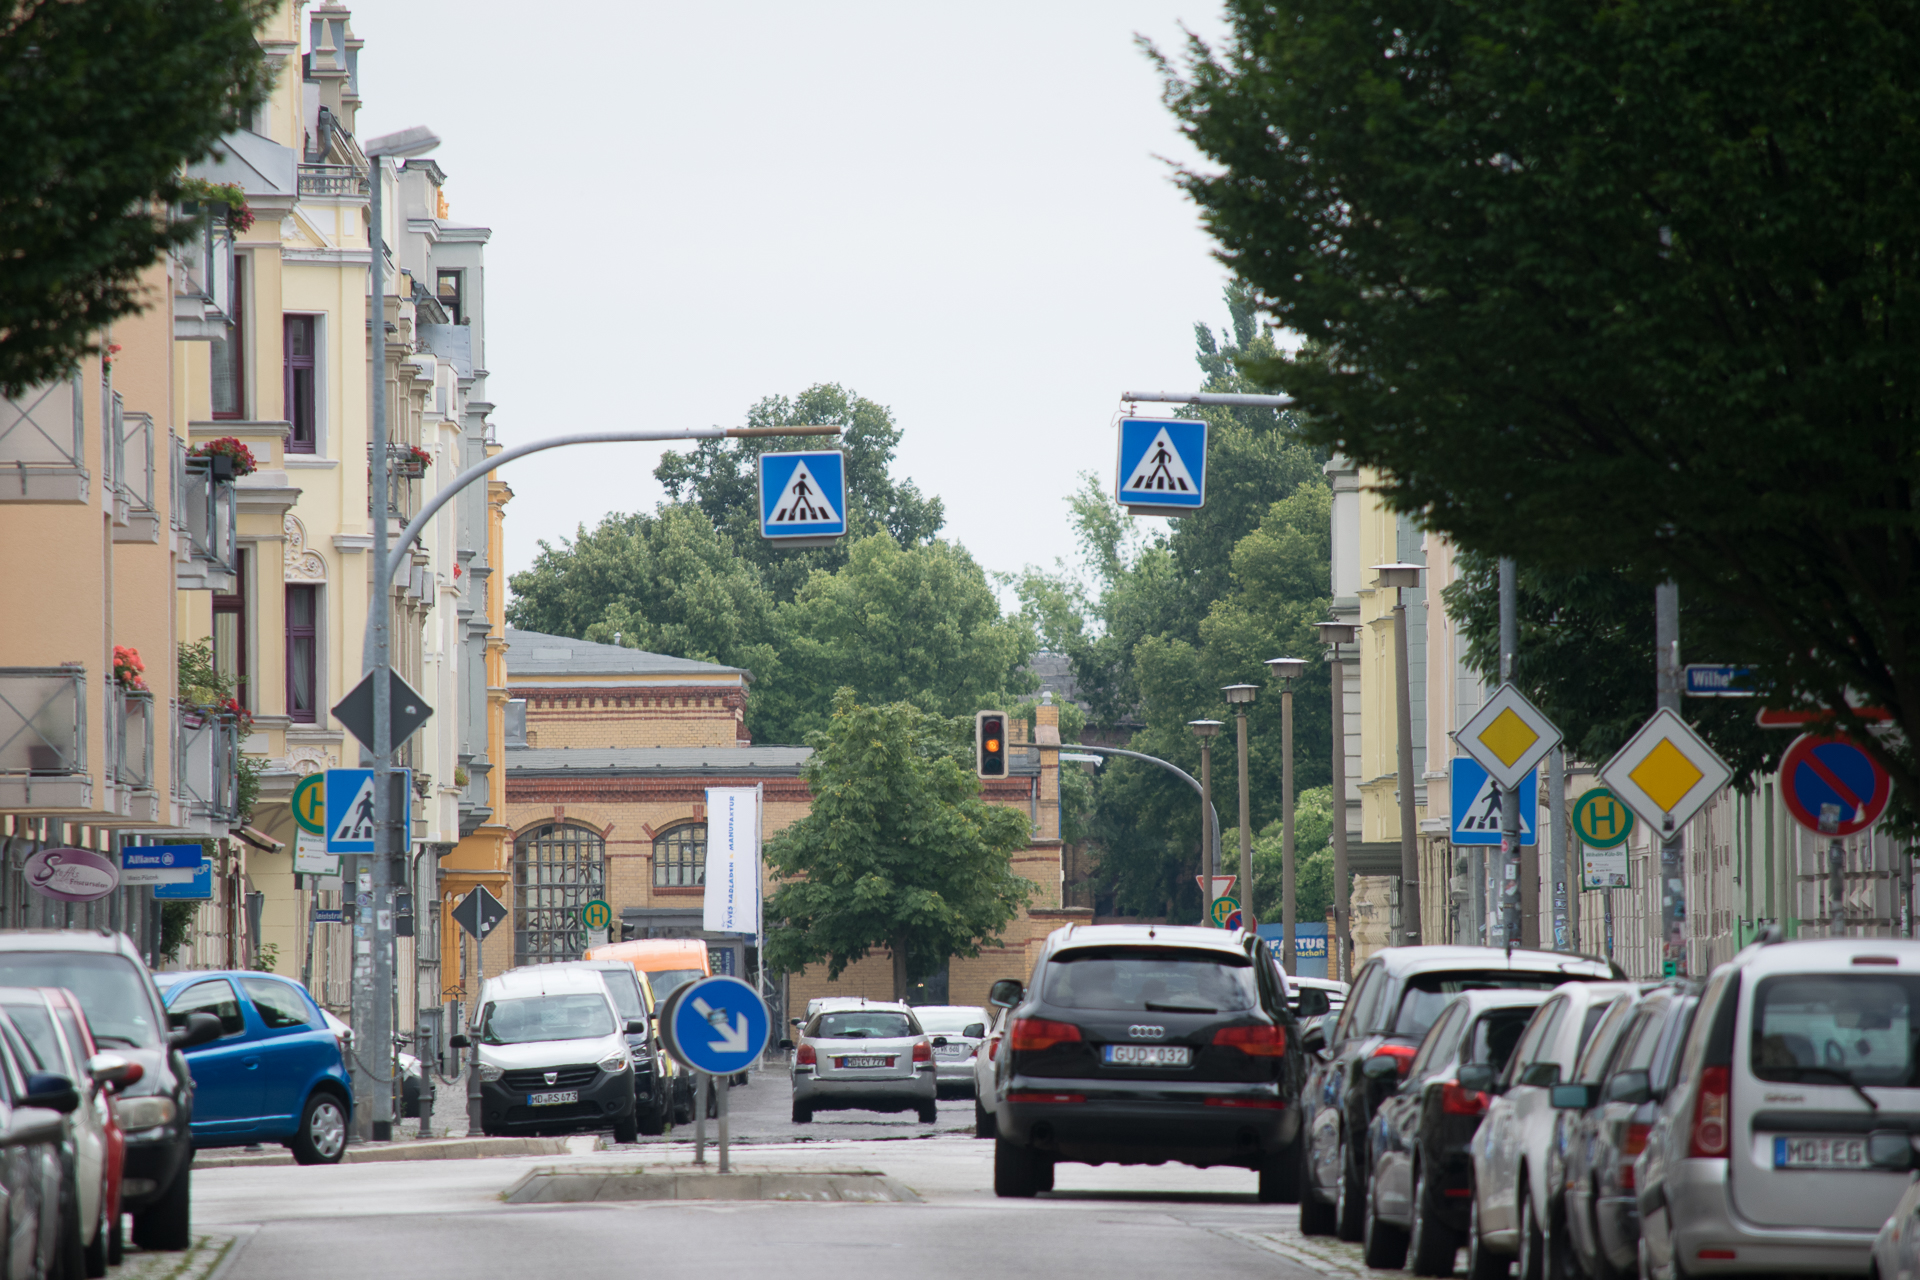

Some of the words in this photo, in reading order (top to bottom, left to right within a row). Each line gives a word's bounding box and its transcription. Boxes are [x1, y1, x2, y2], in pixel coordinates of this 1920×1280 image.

[1590, 801, 1616, 836] H
[127, 855, 160, 864] Allianz
[1115, 1047, 1148, 1061] GUD
[1157, 1048, 1185, 1062] 032
[1788, 1141, 1817, 1162] MD
[1831, 1141, 1862, 1162] EG
